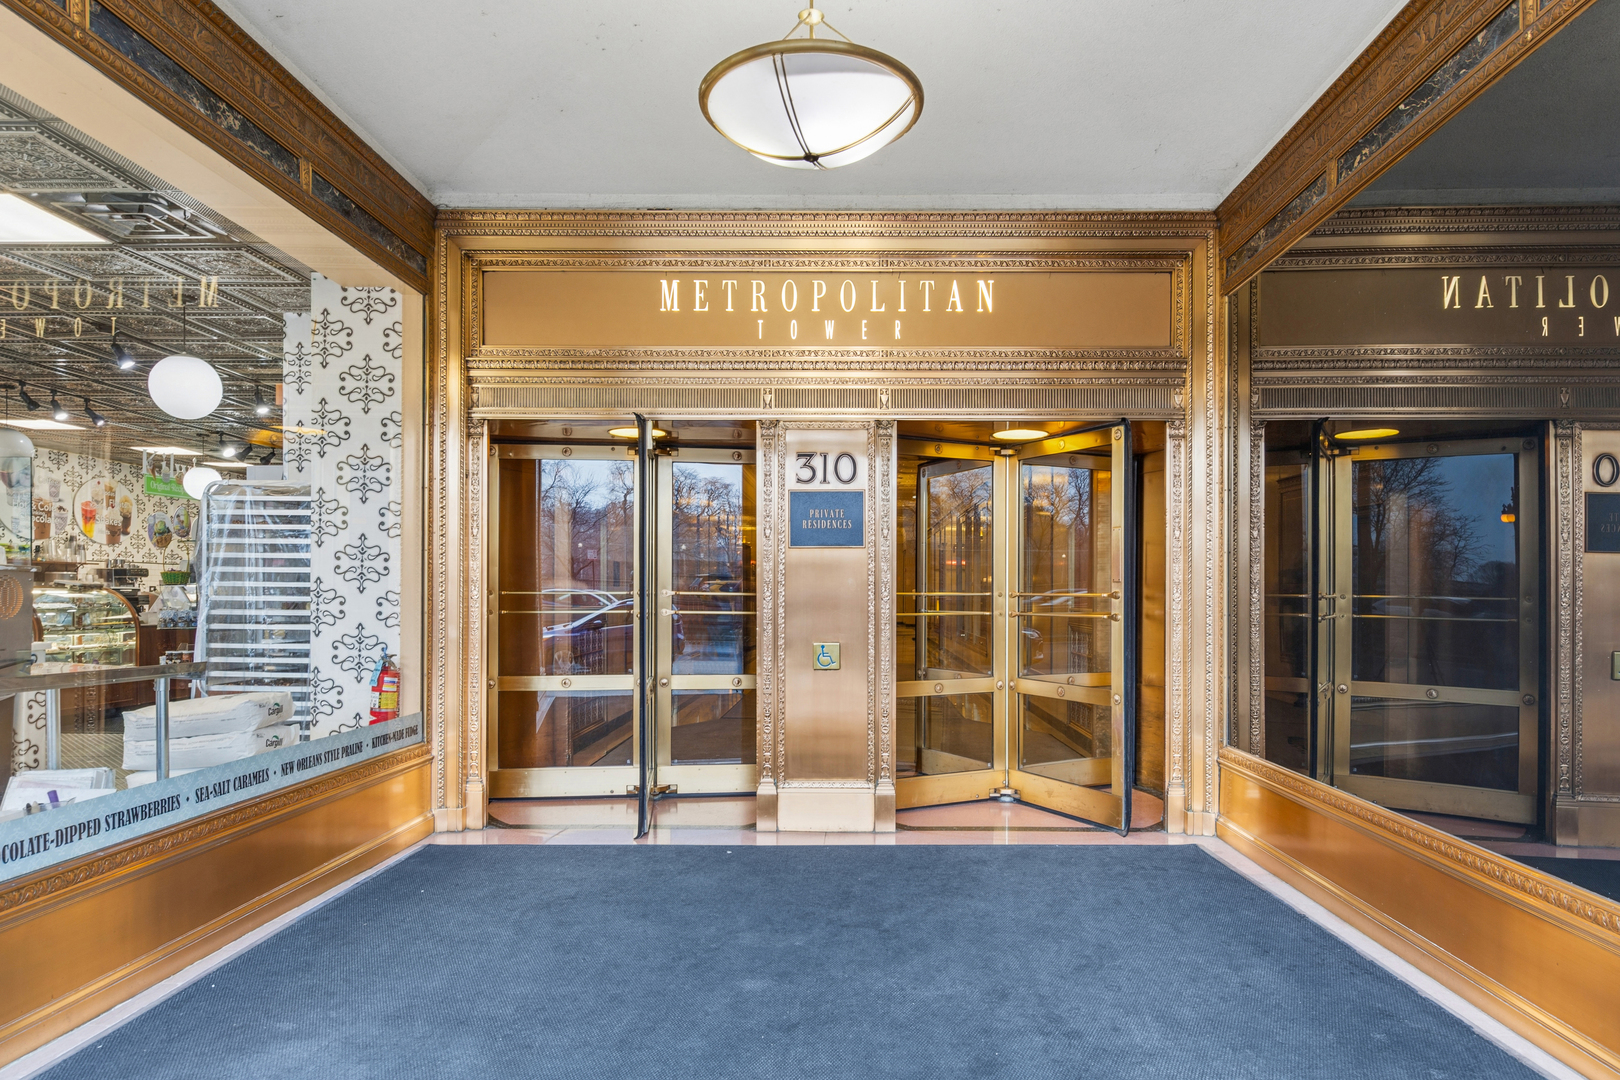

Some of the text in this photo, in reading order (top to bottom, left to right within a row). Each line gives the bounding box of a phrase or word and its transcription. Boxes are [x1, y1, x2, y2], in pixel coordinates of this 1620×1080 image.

[659, 279, 995, 313] METROPOLITAN
[757, 319, 901, 340] TOWER
[795, 451, 858, 485] 310
[809, 508, 845, 518] PRIVATE
[802, 519, 852, 529] RESIDENCES
[267, 704, 284, 716] Cargill
[265, 737, 284, 748] Cargill
[104, 793, 181, 832] STRAWBERRIES
[195, 778, 231, 803] SEA-SALT
[233, 767, 270, 791] CARAMELS
[281, 760, 295, 777] NEW
[296, 752, 323, 773] ORLEANS
[323, 747, 340, 764] STYLE
[341, 741, 363, 758] PRALINE
[371, 728, 405, 749] KITCHEN-MADE
